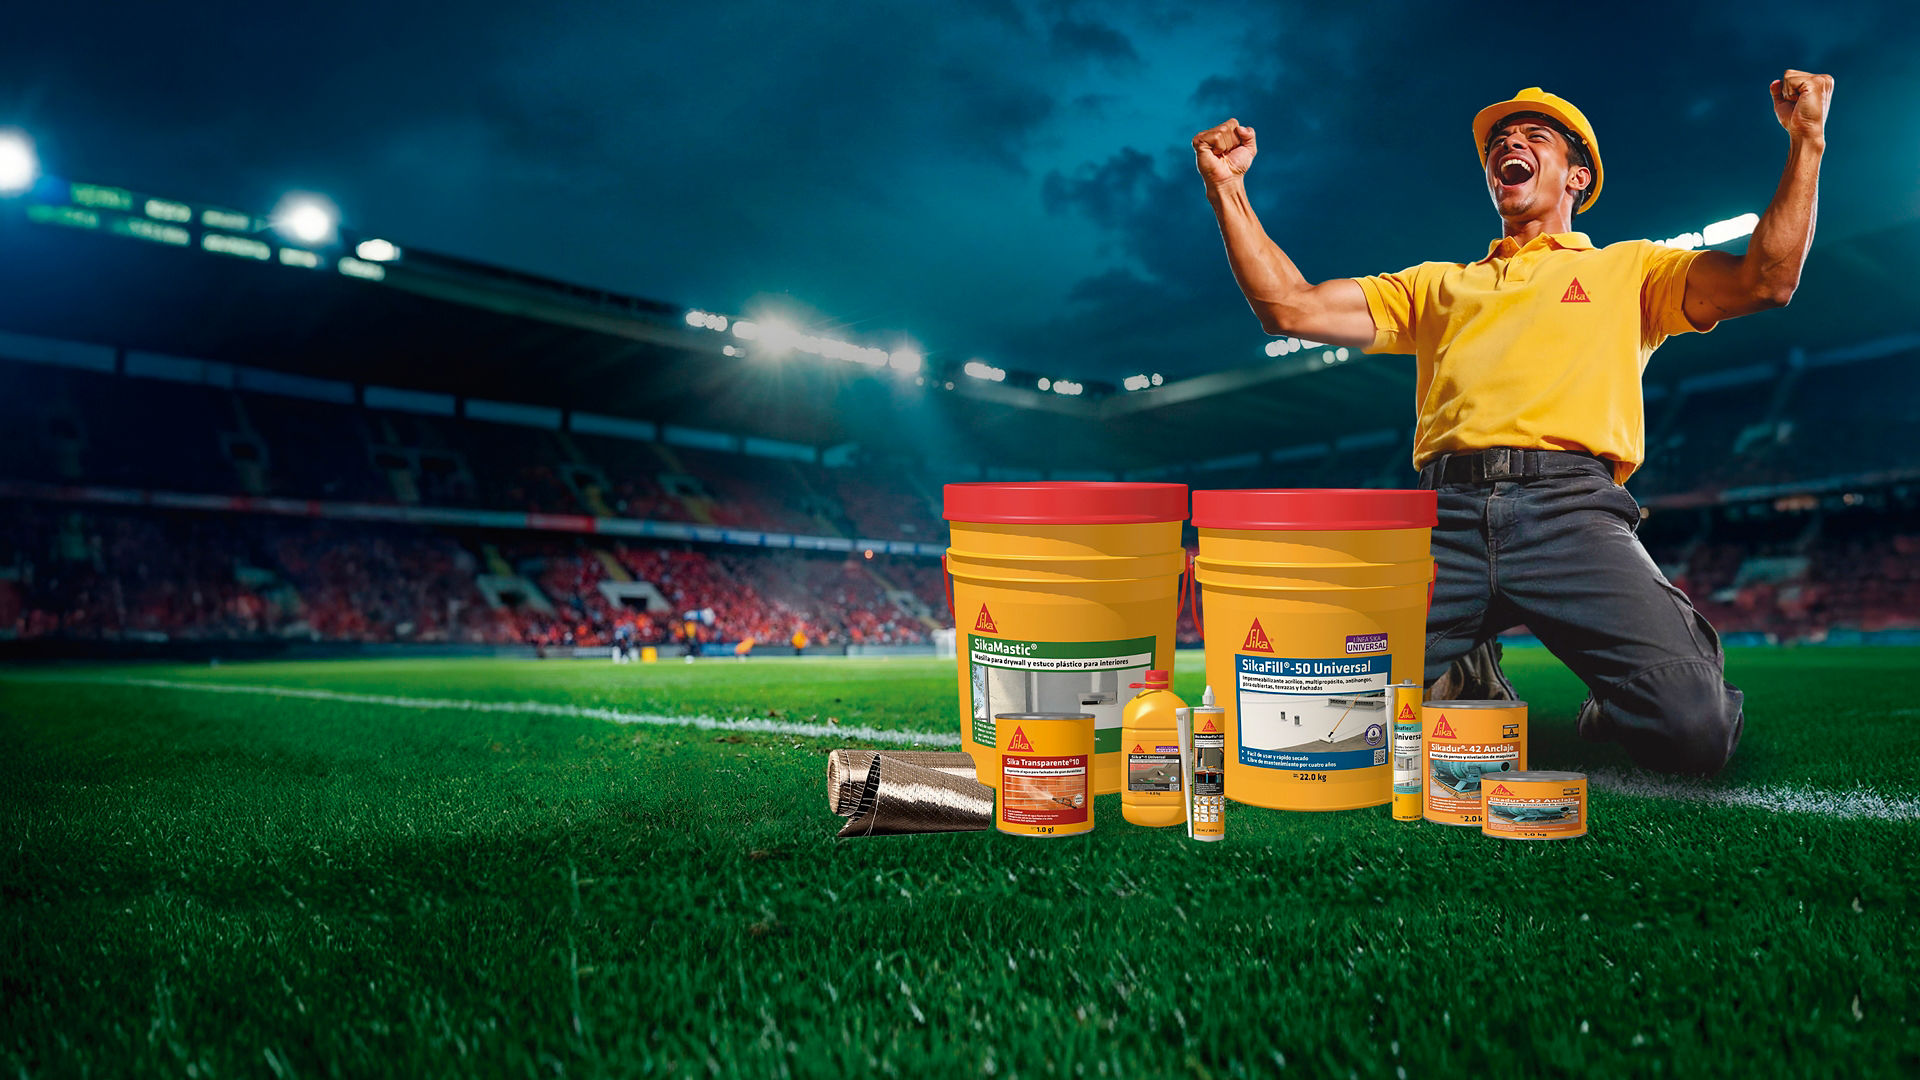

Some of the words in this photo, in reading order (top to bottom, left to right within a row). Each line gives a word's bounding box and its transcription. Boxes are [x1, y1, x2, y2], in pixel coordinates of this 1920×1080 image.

[1564, 286, 1586, 300] Sika
[976, 612, 994, 630] Sika
[1246, 628, 1269, 649] Sika
[1347, 642, 1386, 651] UNIVERSAL
[1314, 660, 1371, 674] Universal
[1242, 675, 1284, 683] Impermeabilizante
[1434, 721, 1452, 736] Sika
[1010, 734, 1029, 750] Sika
[1484, 744, 1514, 752] Anclaje
[1318, 773, 1326, 782] kg
